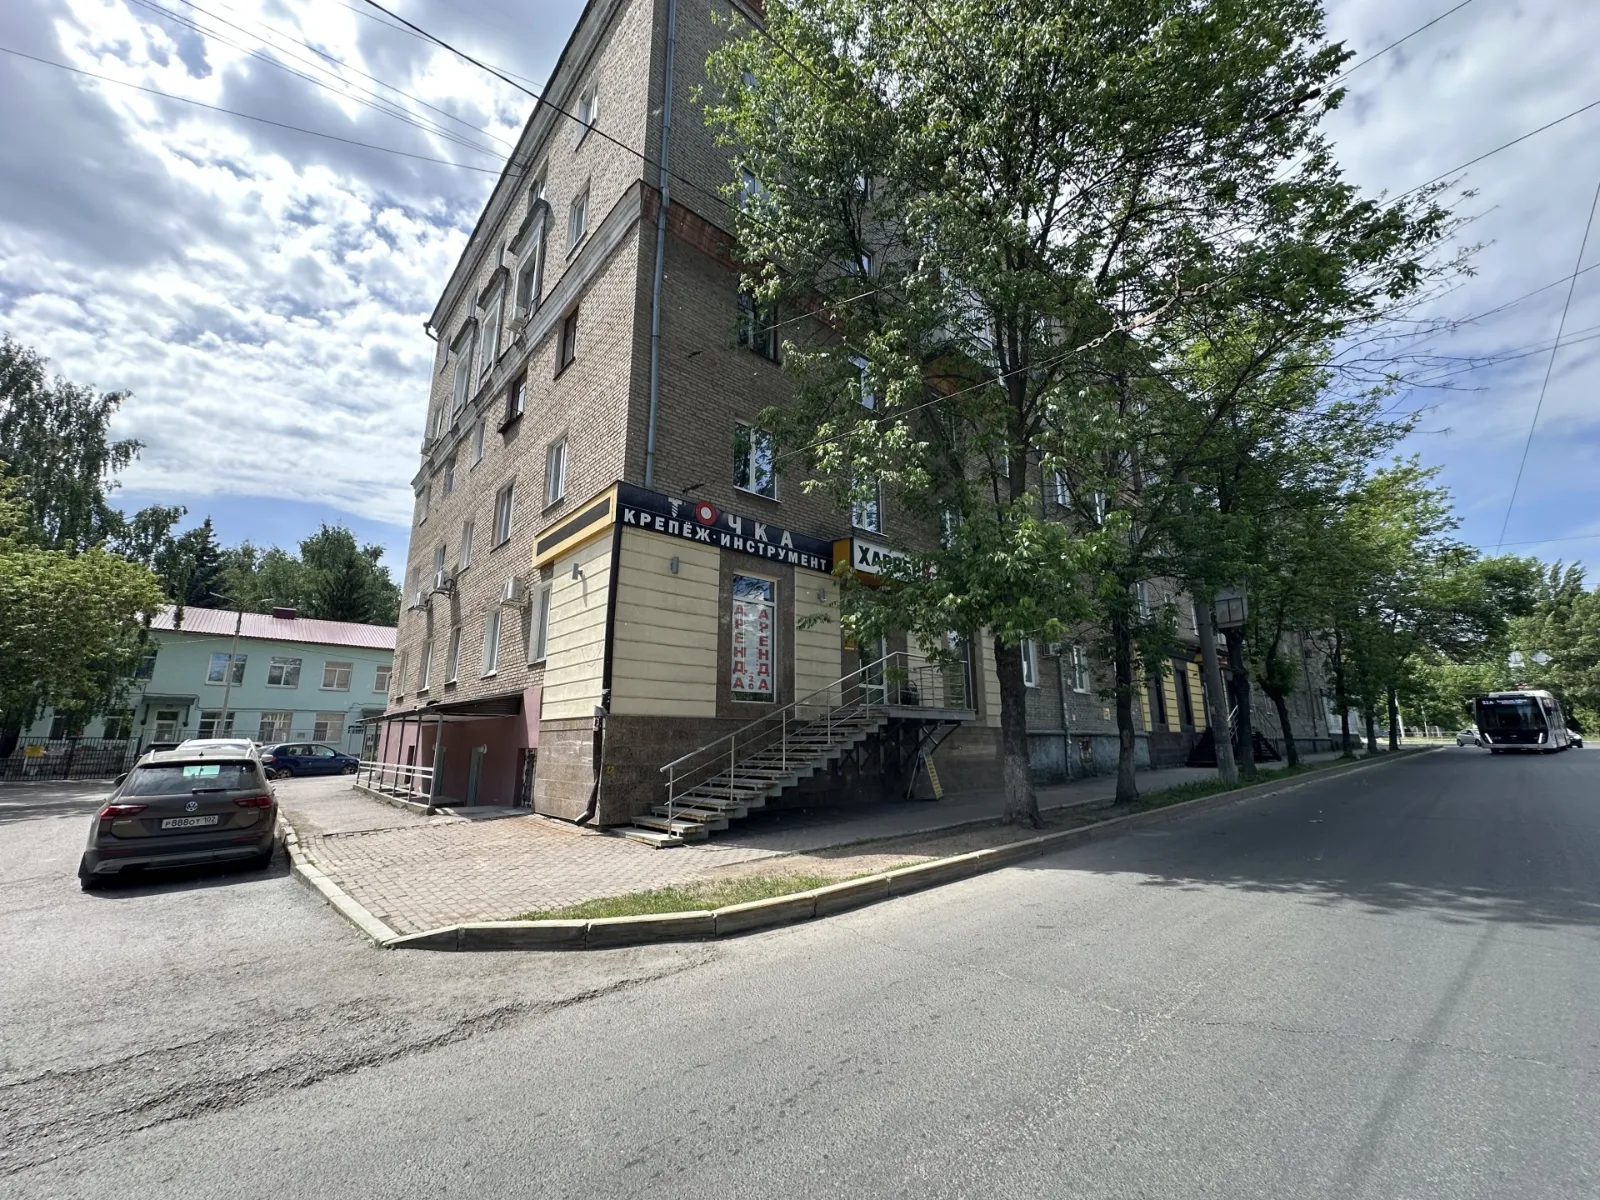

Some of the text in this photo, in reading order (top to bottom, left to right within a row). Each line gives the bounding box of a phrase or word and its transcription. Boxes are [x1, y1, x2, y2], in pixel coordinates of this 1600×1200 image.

[623, 507, 828, 571] КРЕПЁЖ ИНСТРУМЕНТ
[667, 496, 794, 549] ТОЧКА
[732, 604, 748, 689] АРЕНДА
[757, 608, 770, 691] АРЕНДА
